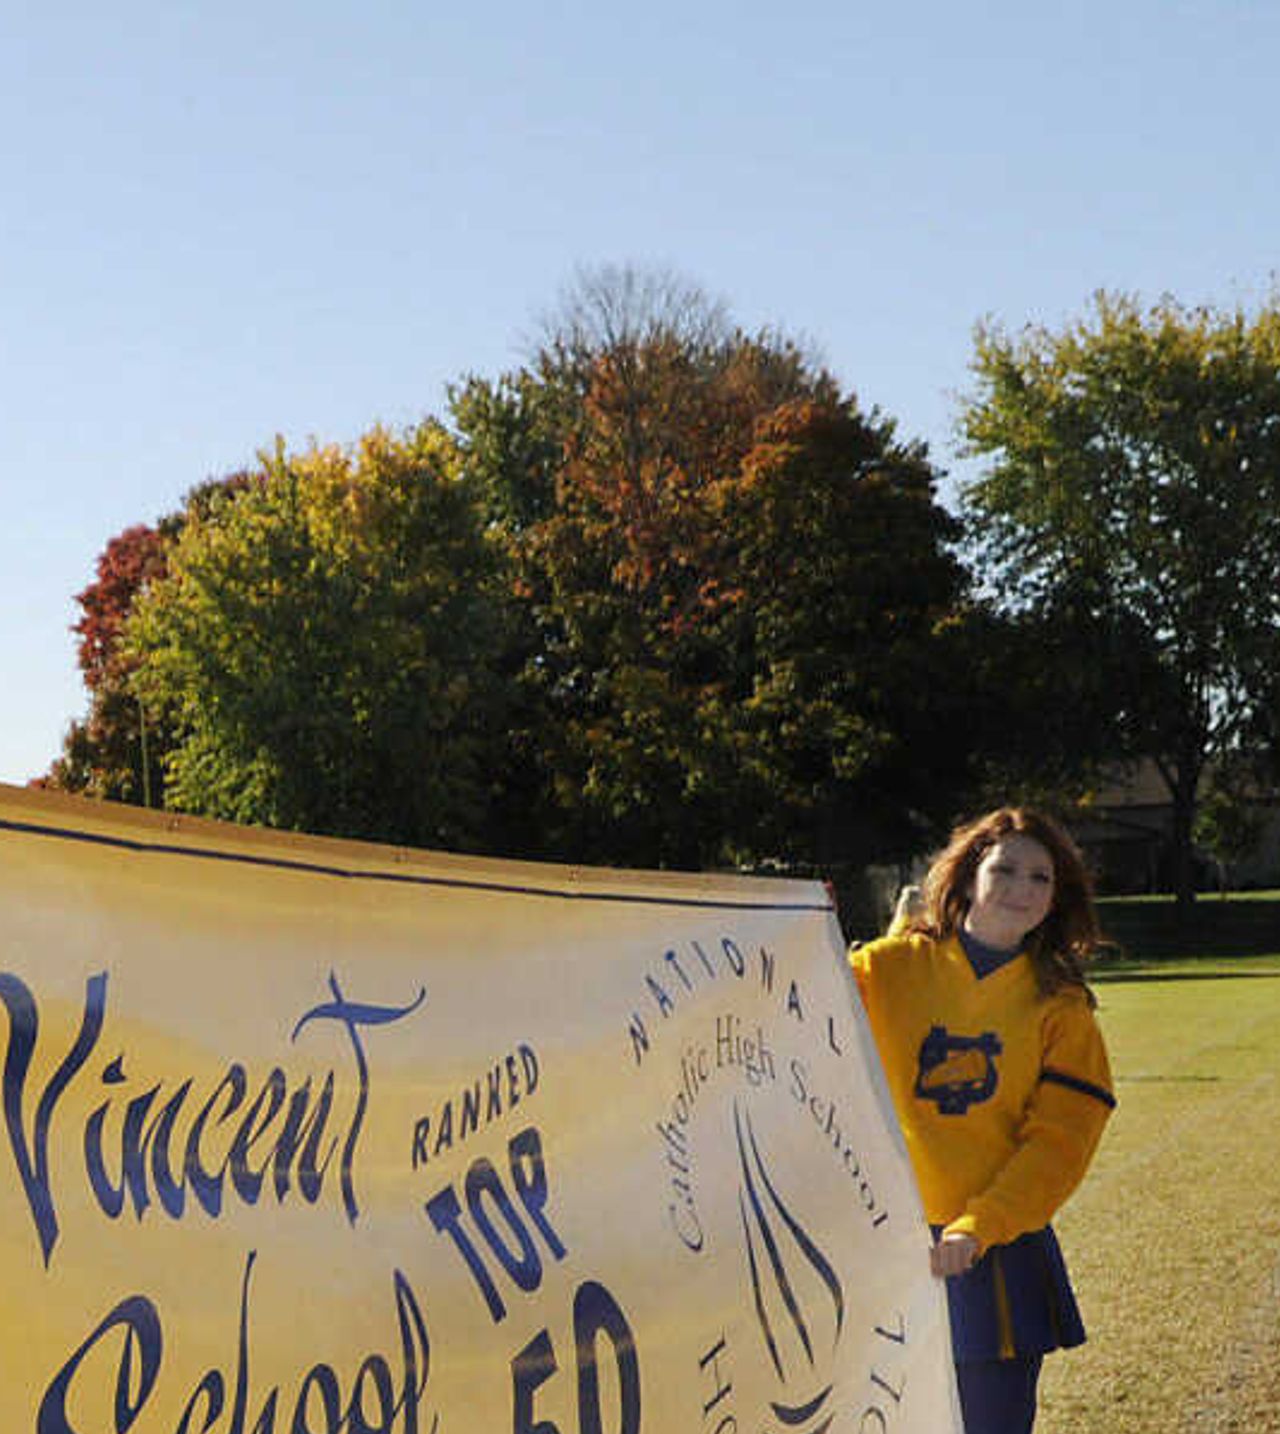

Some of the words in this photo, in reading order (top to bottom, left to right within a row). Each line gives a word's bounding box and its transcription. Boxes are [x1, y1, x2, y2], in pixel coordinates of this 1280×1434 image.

[628, 937, 843, 1067] NATIONAL
[411, 1043, 540, 1170] RANKED
[656, 1045, 711, 1252] Catholic
[715, 1013, 776, 1087] High
[789, 1058, 889, 1229] School
[424, 1126, 567, 1324] TOP
